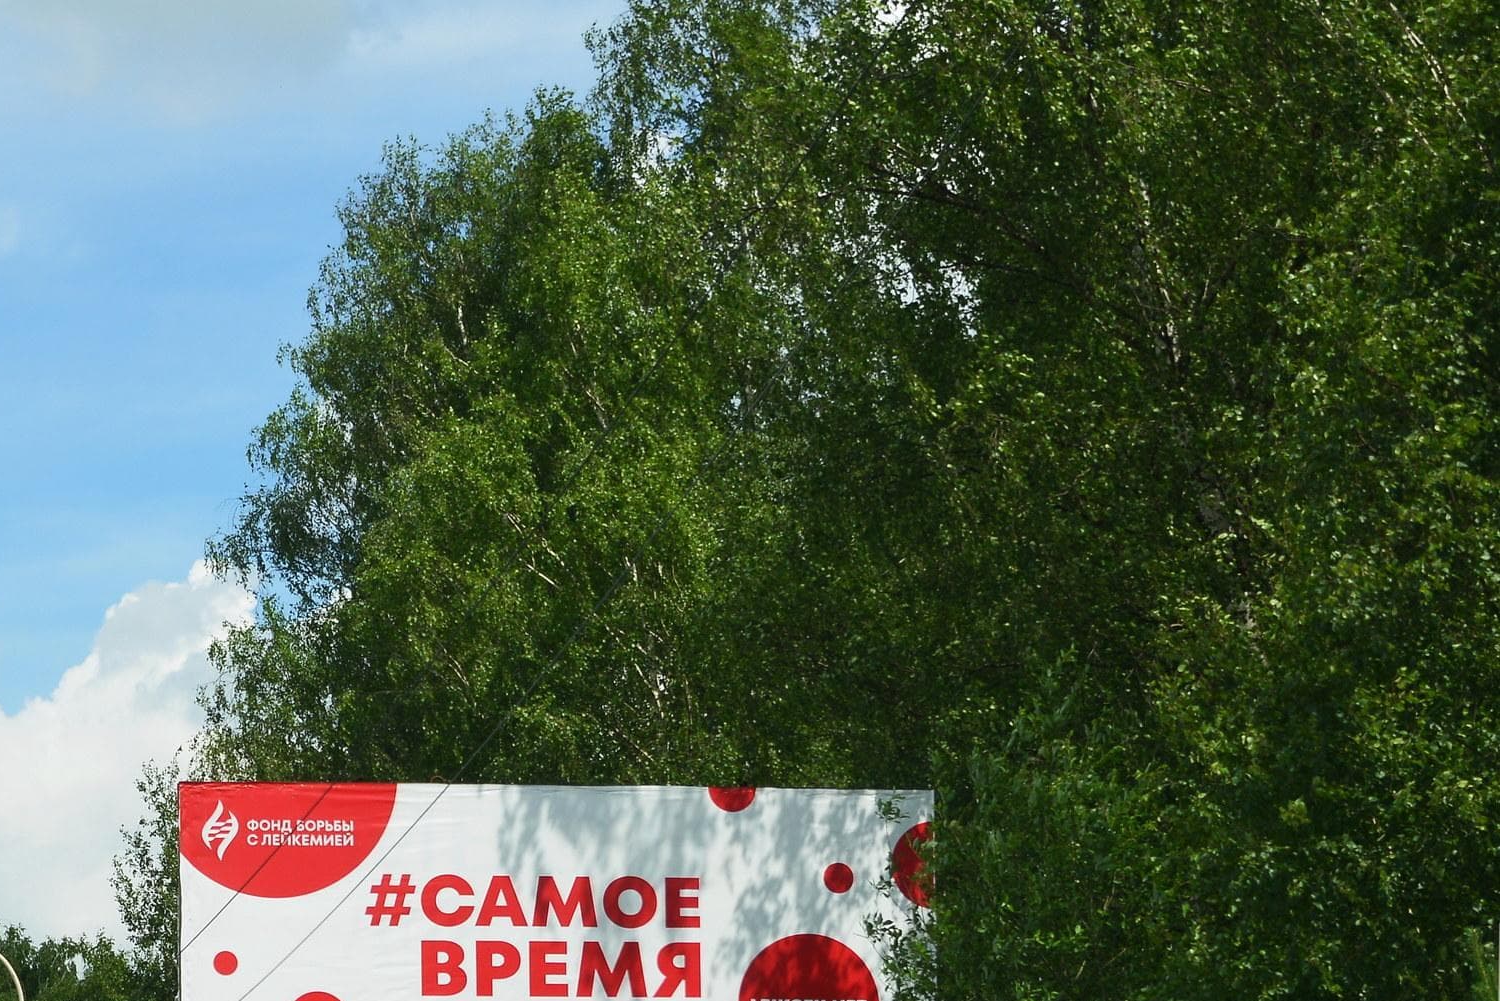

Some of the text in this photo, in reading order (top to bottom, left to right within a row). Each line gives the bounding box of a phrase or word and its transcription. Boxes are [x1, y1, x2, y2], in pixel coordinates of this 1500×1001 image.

[246, 819, 354, 833] ФОНД БОРЬБЫ
[246, 832, 354, 846] С ЛЕЙКЕМИЕЙ
[365, 874, 700, 929] #САМОЕ
[421, 940, 701, 998] ВРЕМЯ
